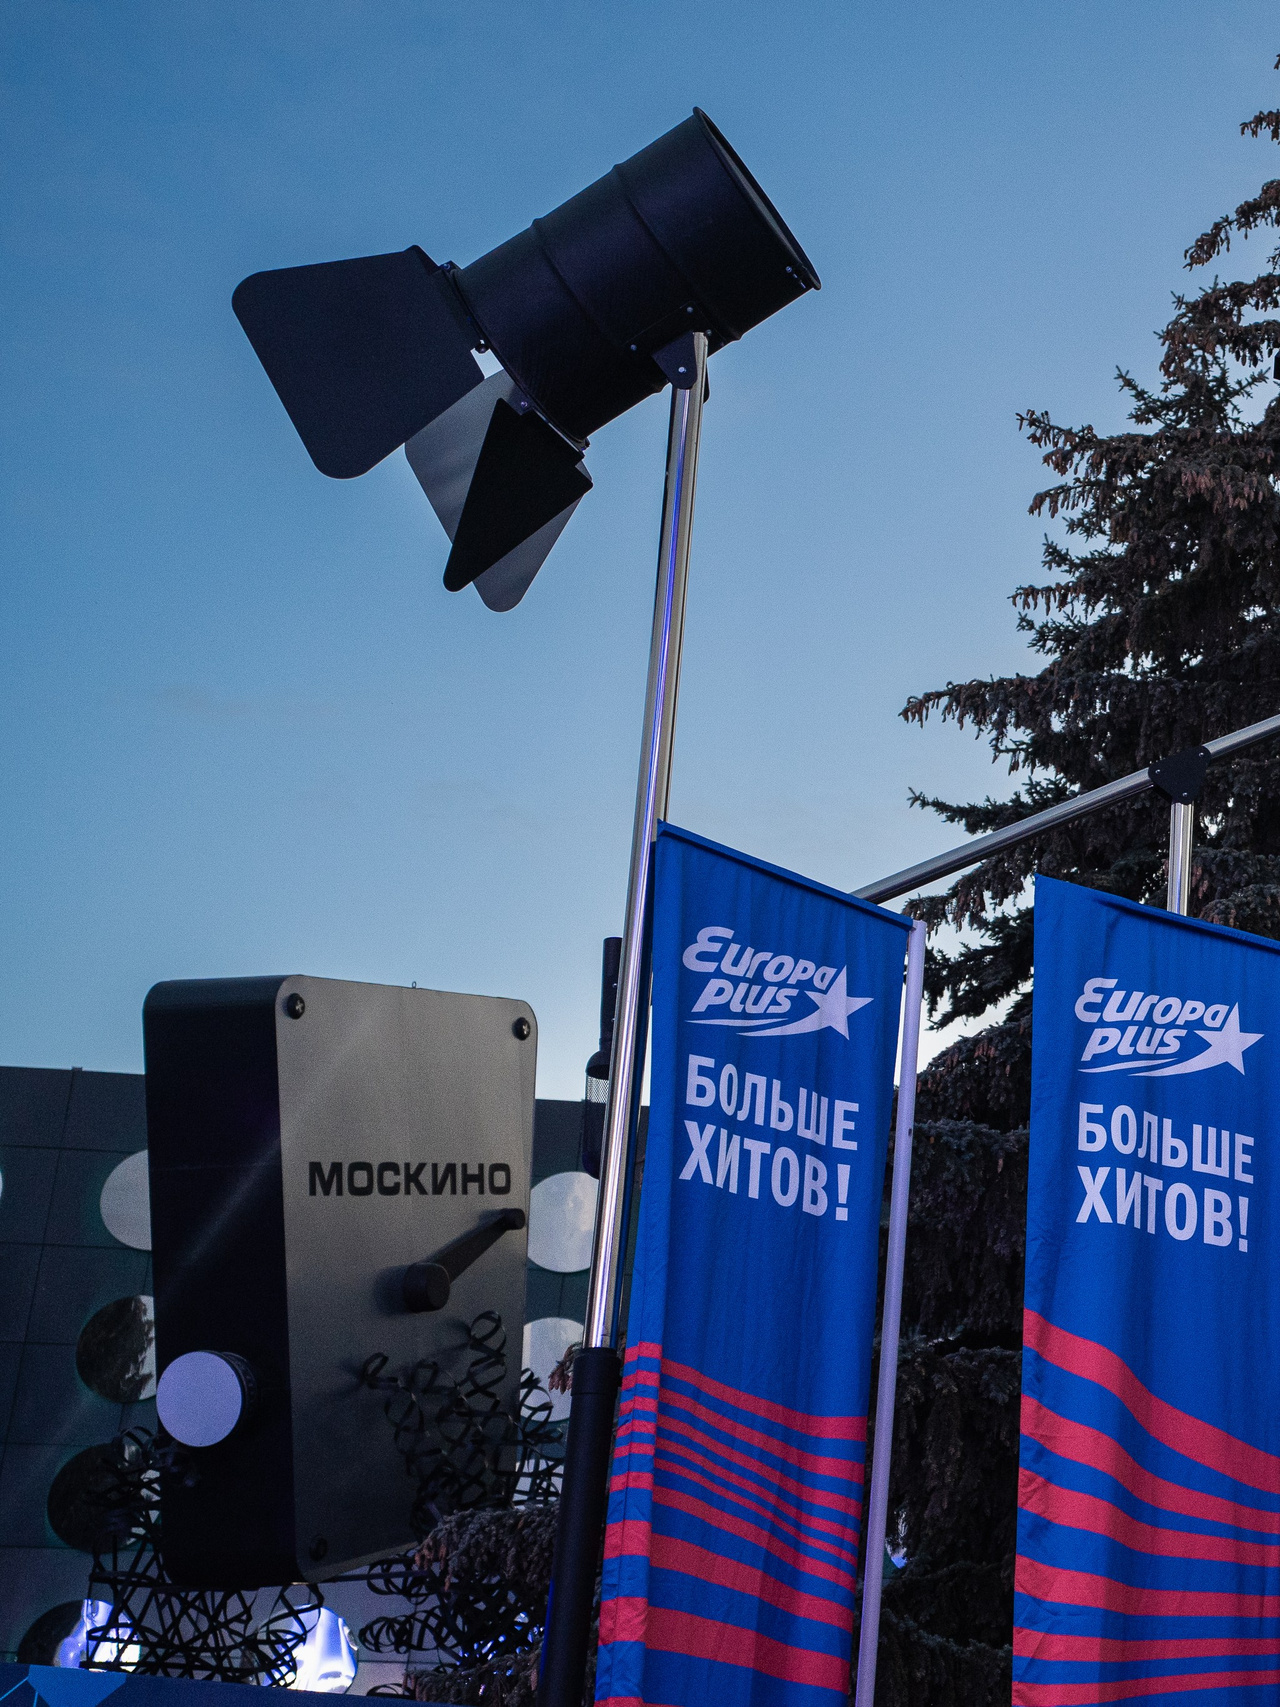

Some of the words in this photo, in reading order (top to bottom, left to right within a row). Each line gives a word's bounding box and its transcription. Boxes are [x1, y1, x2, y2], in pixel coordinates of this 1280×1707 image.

[685, 1054, 859, 1151] БОЛЬШЕ
[1078, 1102, 1254, 1184] БОЛЬШЕ
[308, 1160, 512, 1197] МОСКИНО
[679, 1120, 851, 1221] ХИТОВ!
[1075, 1165, 1254, 1253] ХИТОВ!
